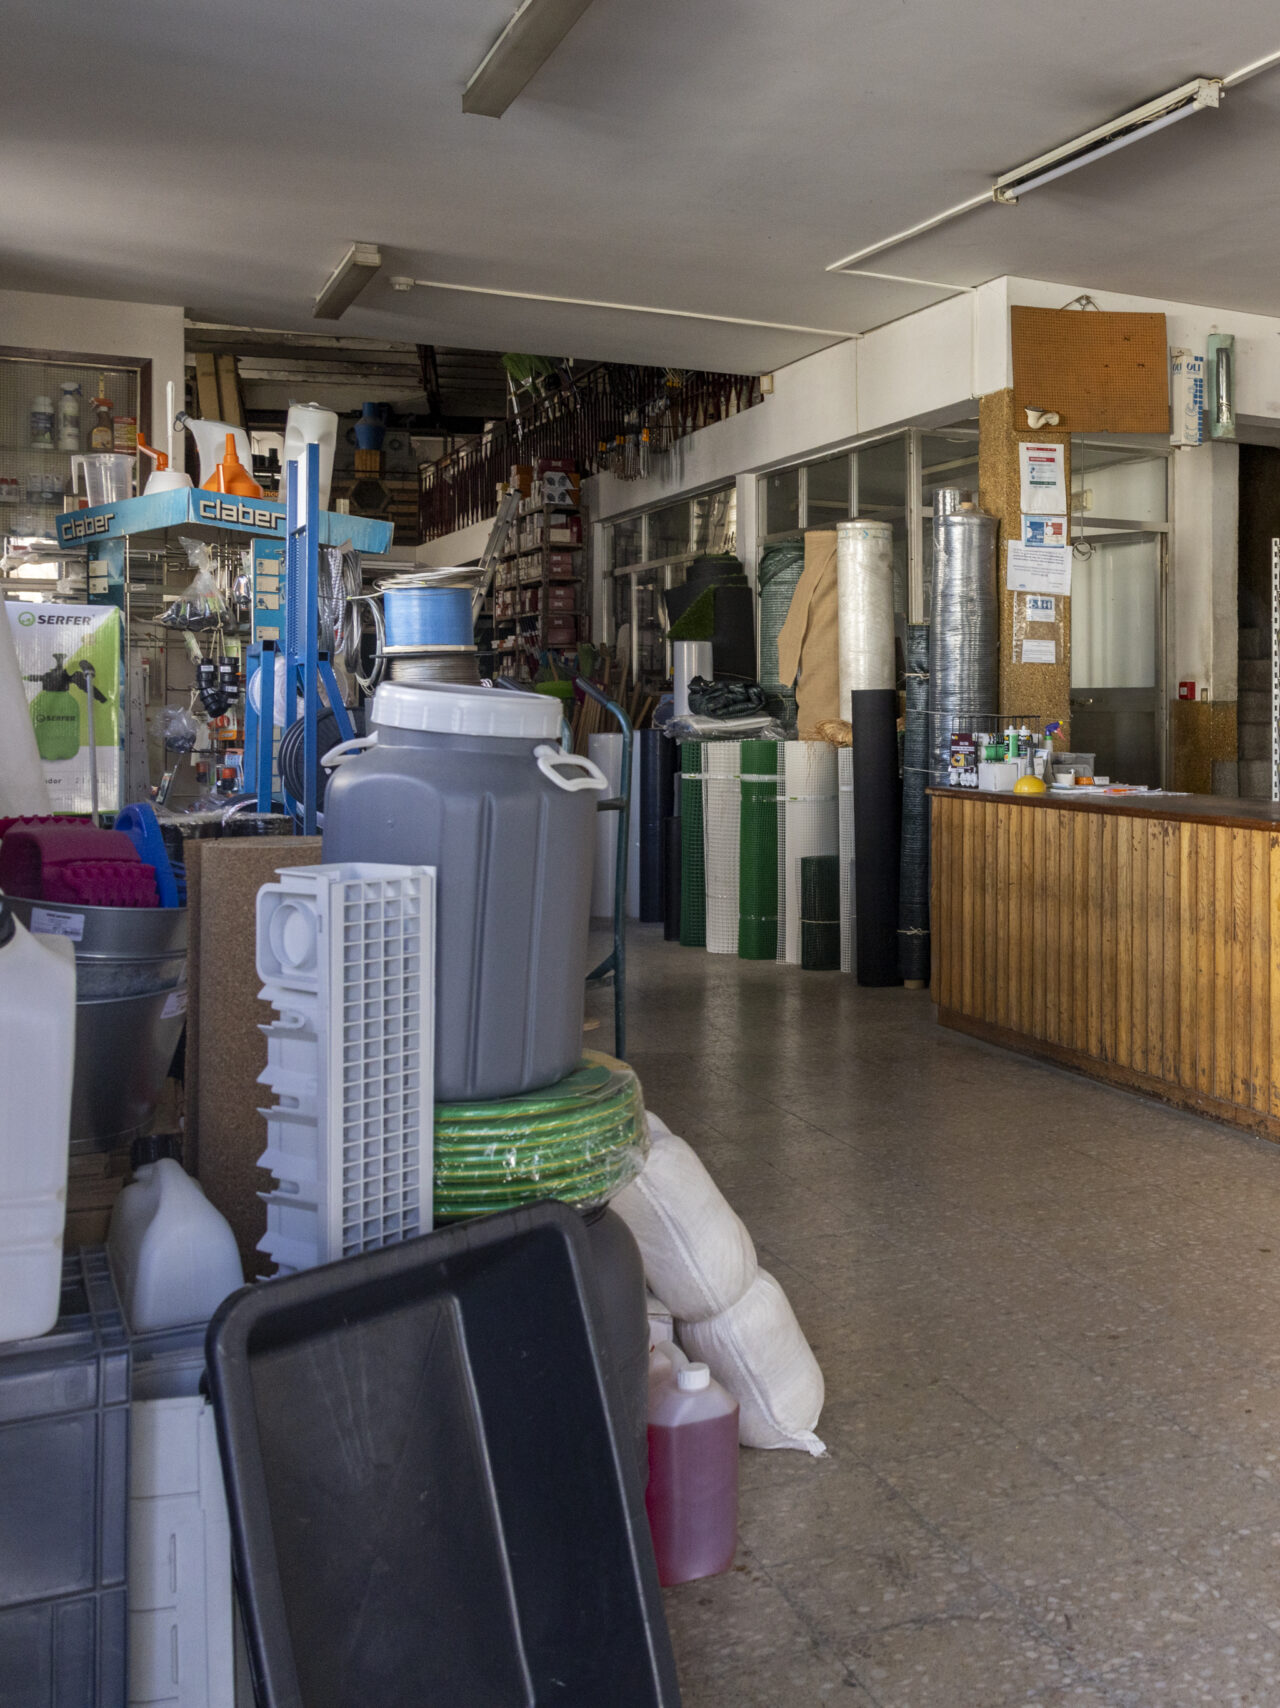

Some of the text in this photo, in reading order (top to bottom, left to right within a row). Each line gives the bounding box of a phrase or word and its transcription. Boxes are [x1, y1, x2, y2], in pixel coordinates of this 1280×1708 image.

[61, 512, 115, 541] claber
[200, 499, 287, 530] claber
[37, 614, 92, 626] SERFER
